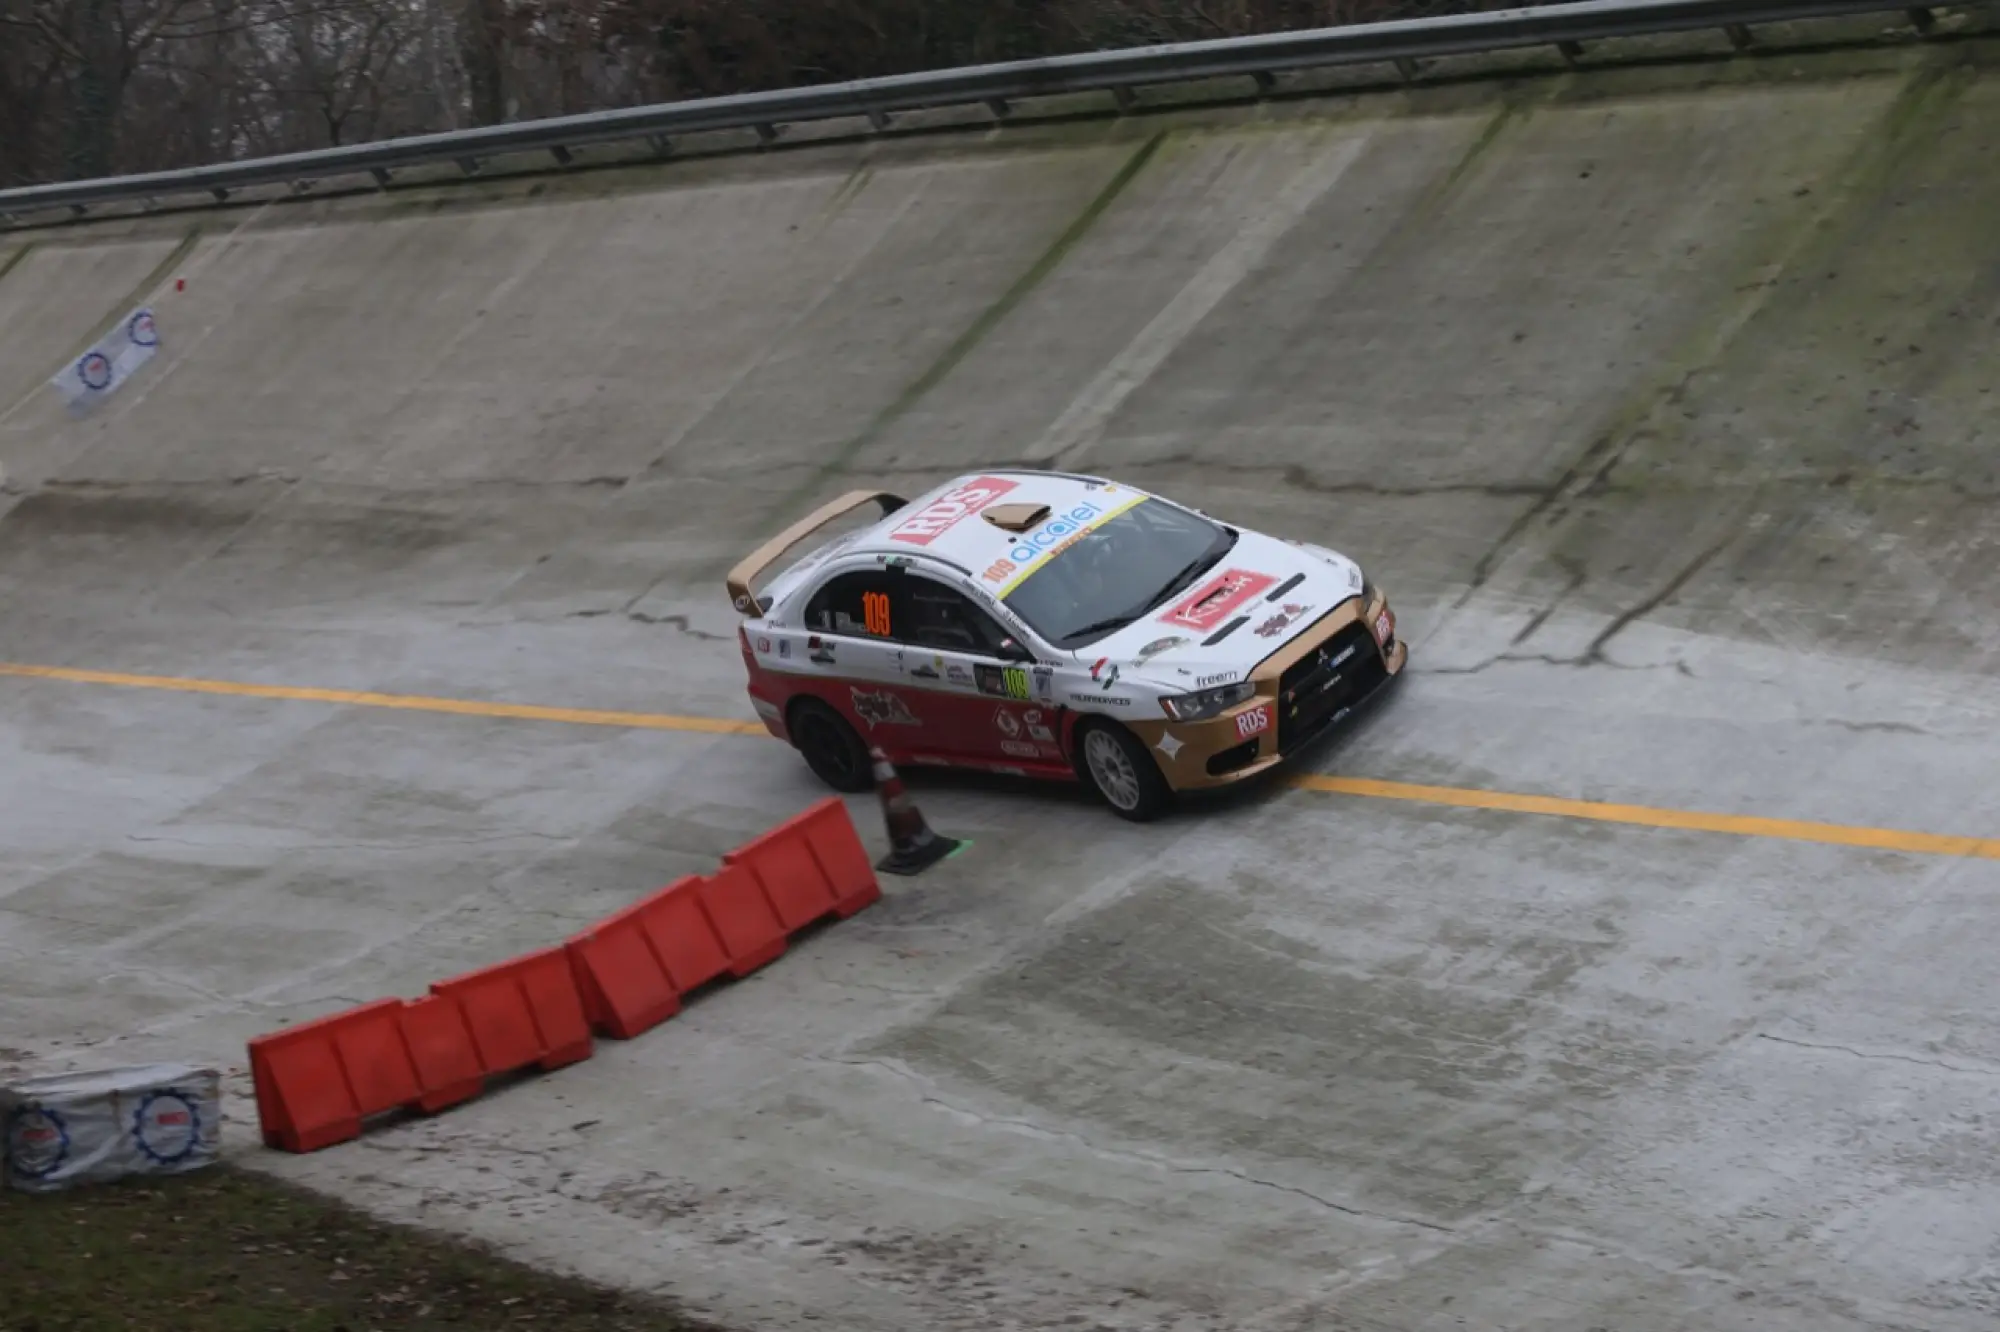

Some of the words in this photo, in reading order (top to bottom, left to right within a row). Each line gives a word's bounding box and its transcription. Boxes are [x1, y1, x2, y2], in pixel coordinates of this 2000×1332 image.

[902, 486, 993, 537] RDS
[1010, 501, 1102, 562] alcatel
[982, 558, 1016, 584] 109
[862, 591, 891, 637] 109
[1003, 667, 1029, 699] 109
[1236, 707, 1269, 738] RDS
